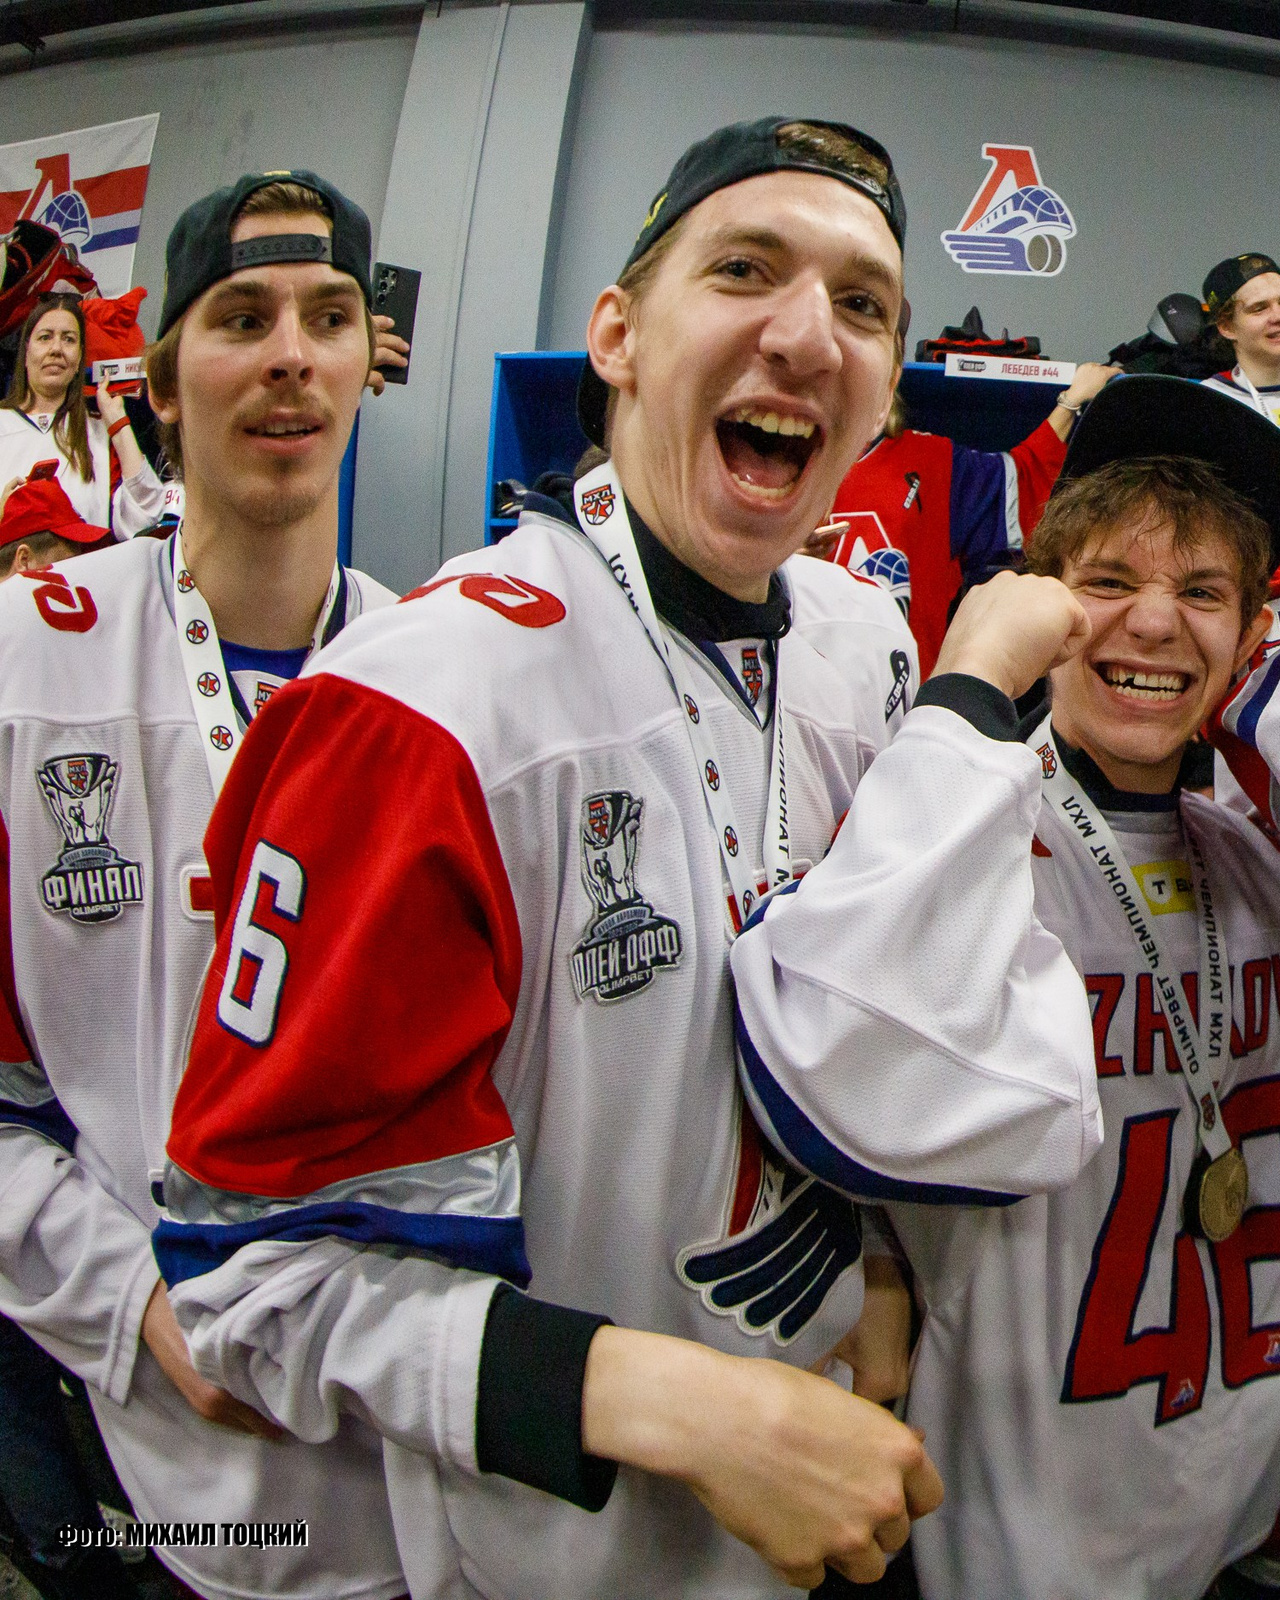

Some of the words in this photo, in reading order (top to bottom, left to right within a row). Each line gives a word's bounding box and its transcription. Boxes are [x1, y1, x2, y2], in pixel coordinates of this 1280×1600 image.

[1001, 363, 1040, 377] ЛЕБЕДЕВ
[1042, 367, 1059, 378] #44
[583, 489, 610, 504] МХЛ
[258, 690, 273, 702] МХ
[1060, 795, 1098, 839] МХЛ
[43, 865, 142, 908] ФИНАЛ
[1089, 844, 1160, 970] ЧЕМПИОНАТ
[216, 838, 307, 1050] 6
[572, 924, 680, 994] ПЛЕЙ-ОФФ
[1199, 876, 1224, 1004] ЧЕМПИОНАТ
[599, 969, 651, 992] OLIMPBET
[1208, 1011, 1224, 1059] МХЛ
